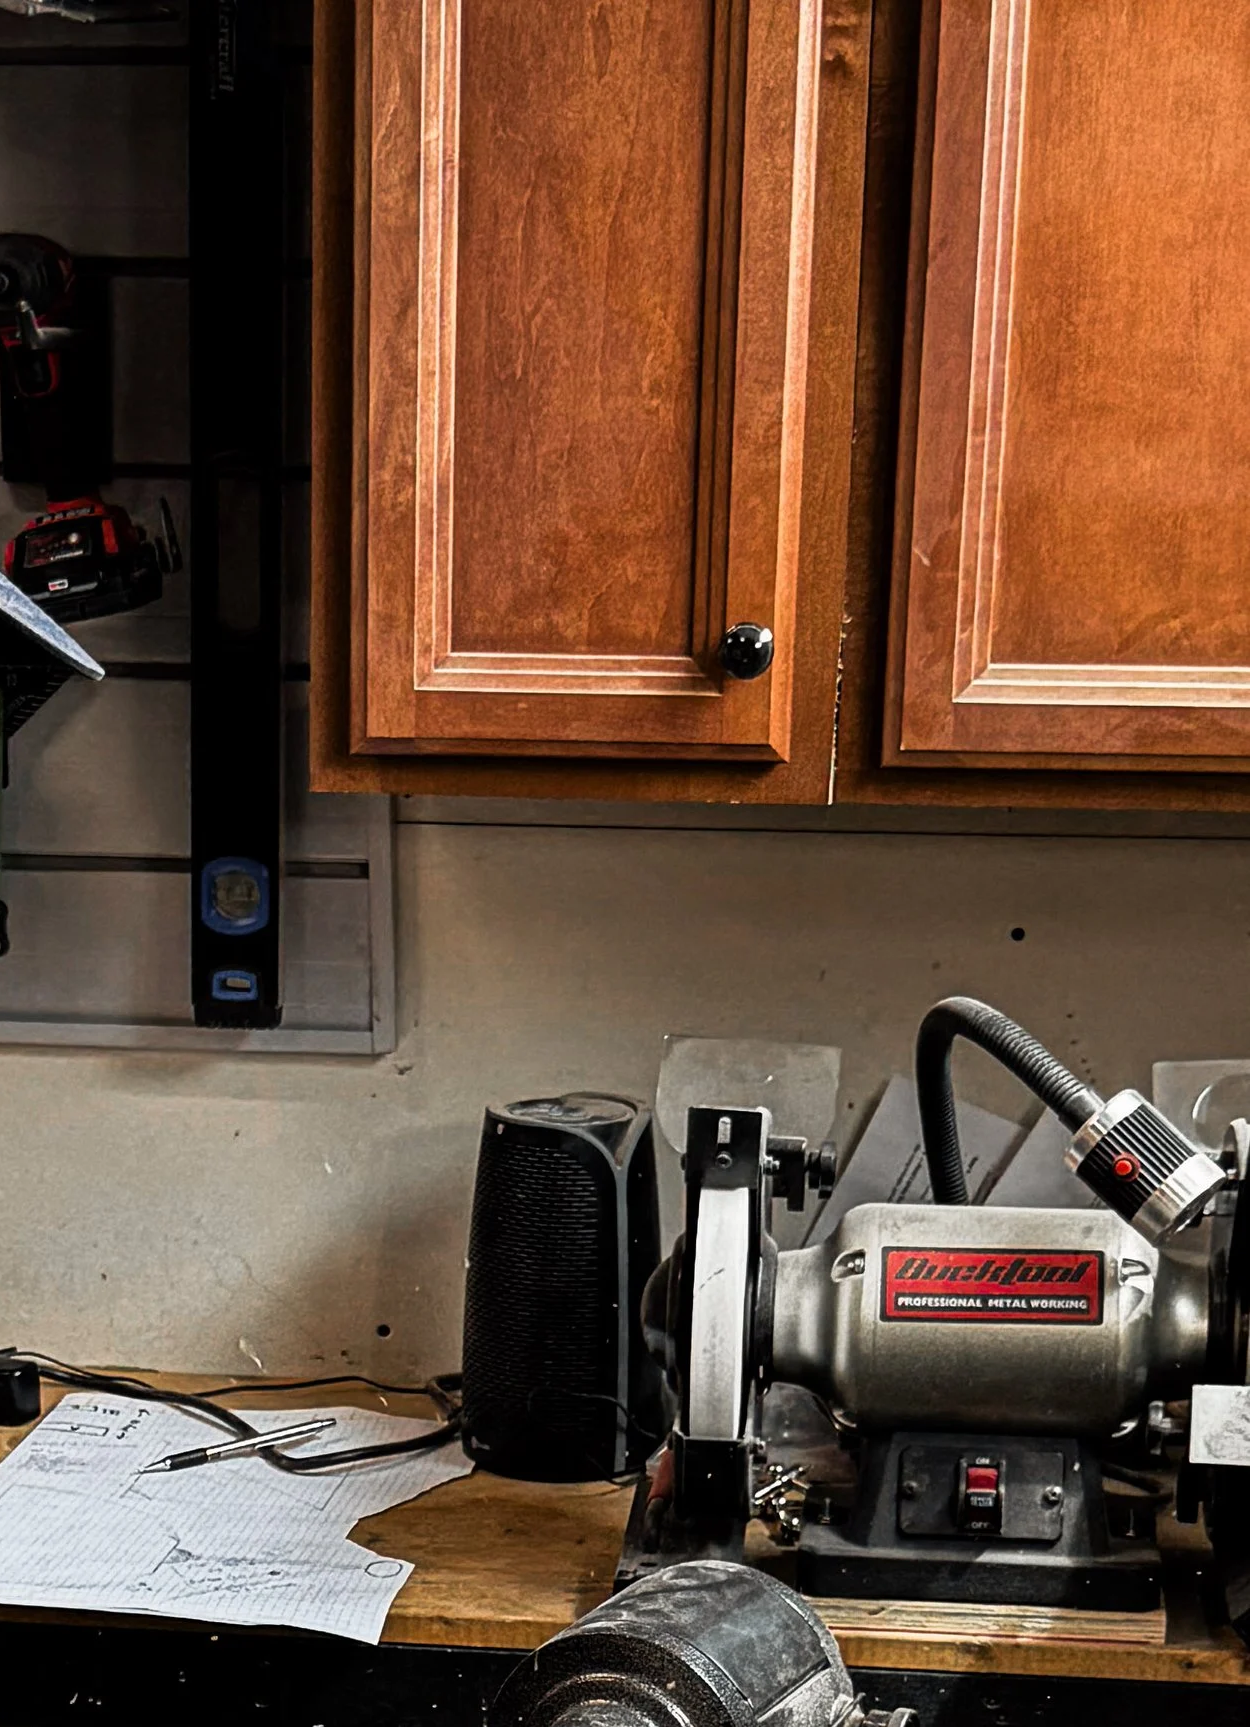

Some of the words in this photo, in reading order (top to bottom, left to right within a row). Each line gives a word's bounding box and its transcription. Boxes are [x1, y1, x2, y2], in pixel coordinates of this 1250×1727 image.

[894, 1257, 1091, 1286] Bucktool
[897, 1296, 983, 1309] PROFESSIONAL
[987, 1298, 1028, 1310] METAL
[1030, 1299, 1088, 1310] WORKING
[975, 1457, 990, 1465] ON
